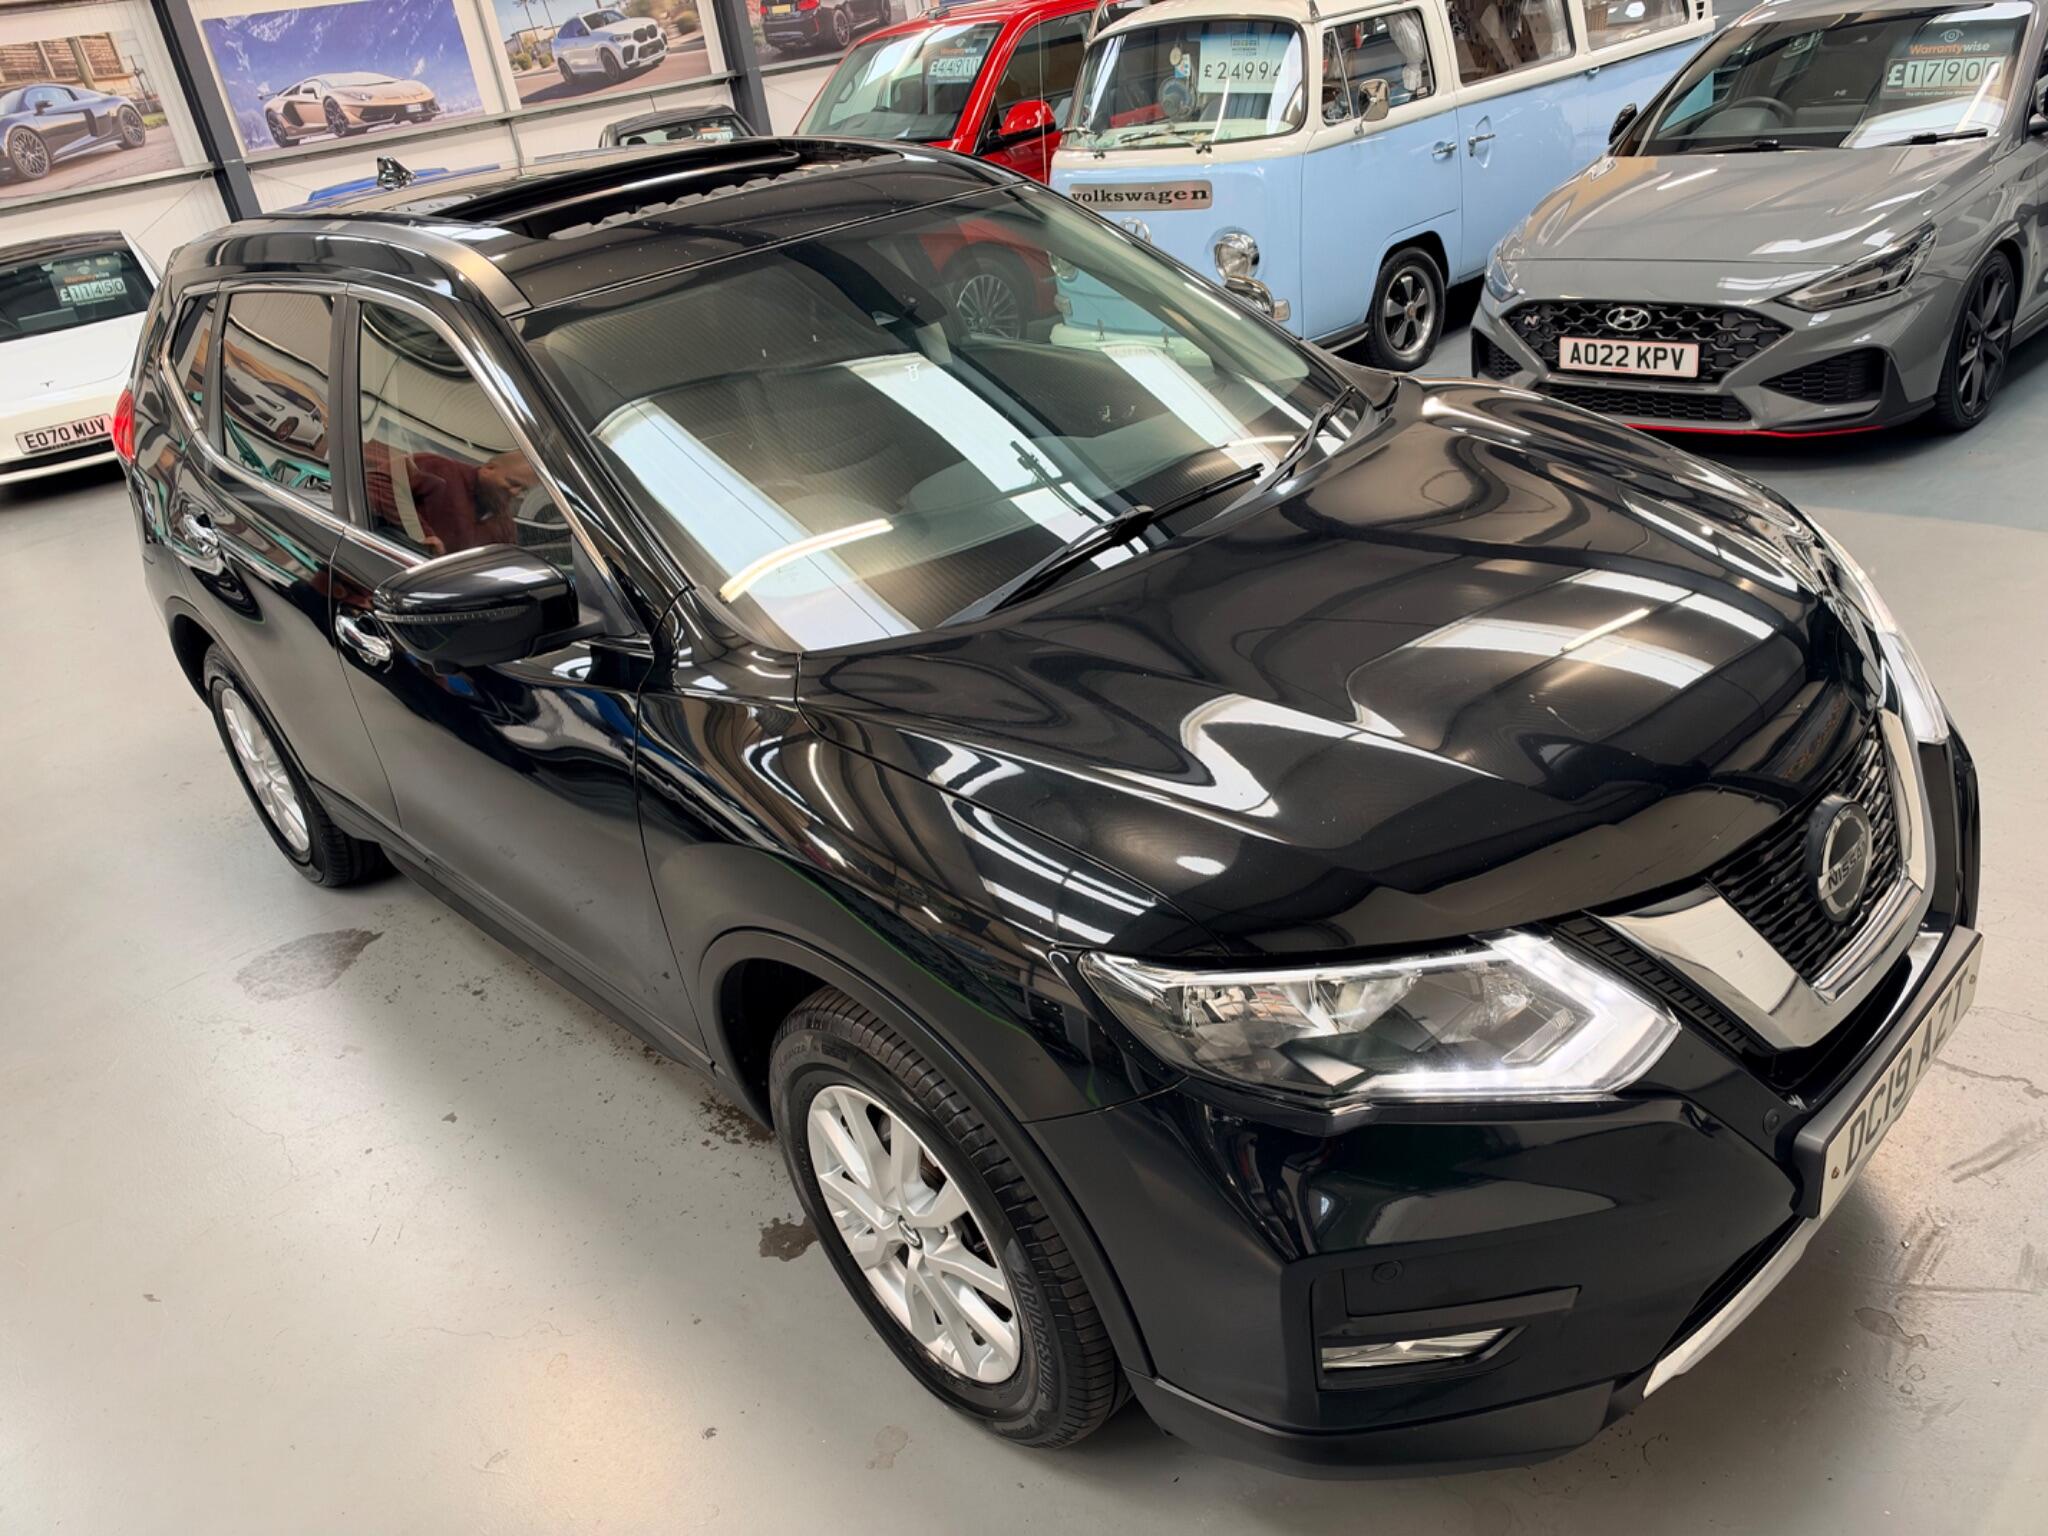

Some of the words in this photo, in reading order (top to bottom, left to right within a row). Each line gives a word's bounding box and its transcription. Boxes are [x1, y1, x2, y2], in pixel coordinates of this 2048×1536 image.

[1910, 41, 1990, 54] Warrantywise
[1072, 189, 1207, 204] volkswagen
[60, 280, 124, 302] £11450
[1637, 346, 1685, 371] KPV
[72, 418, 105, 438] MUV
[1844, 1048, 1912, 1176] DC19
[1916, 966, 1968, 1077] AZT
